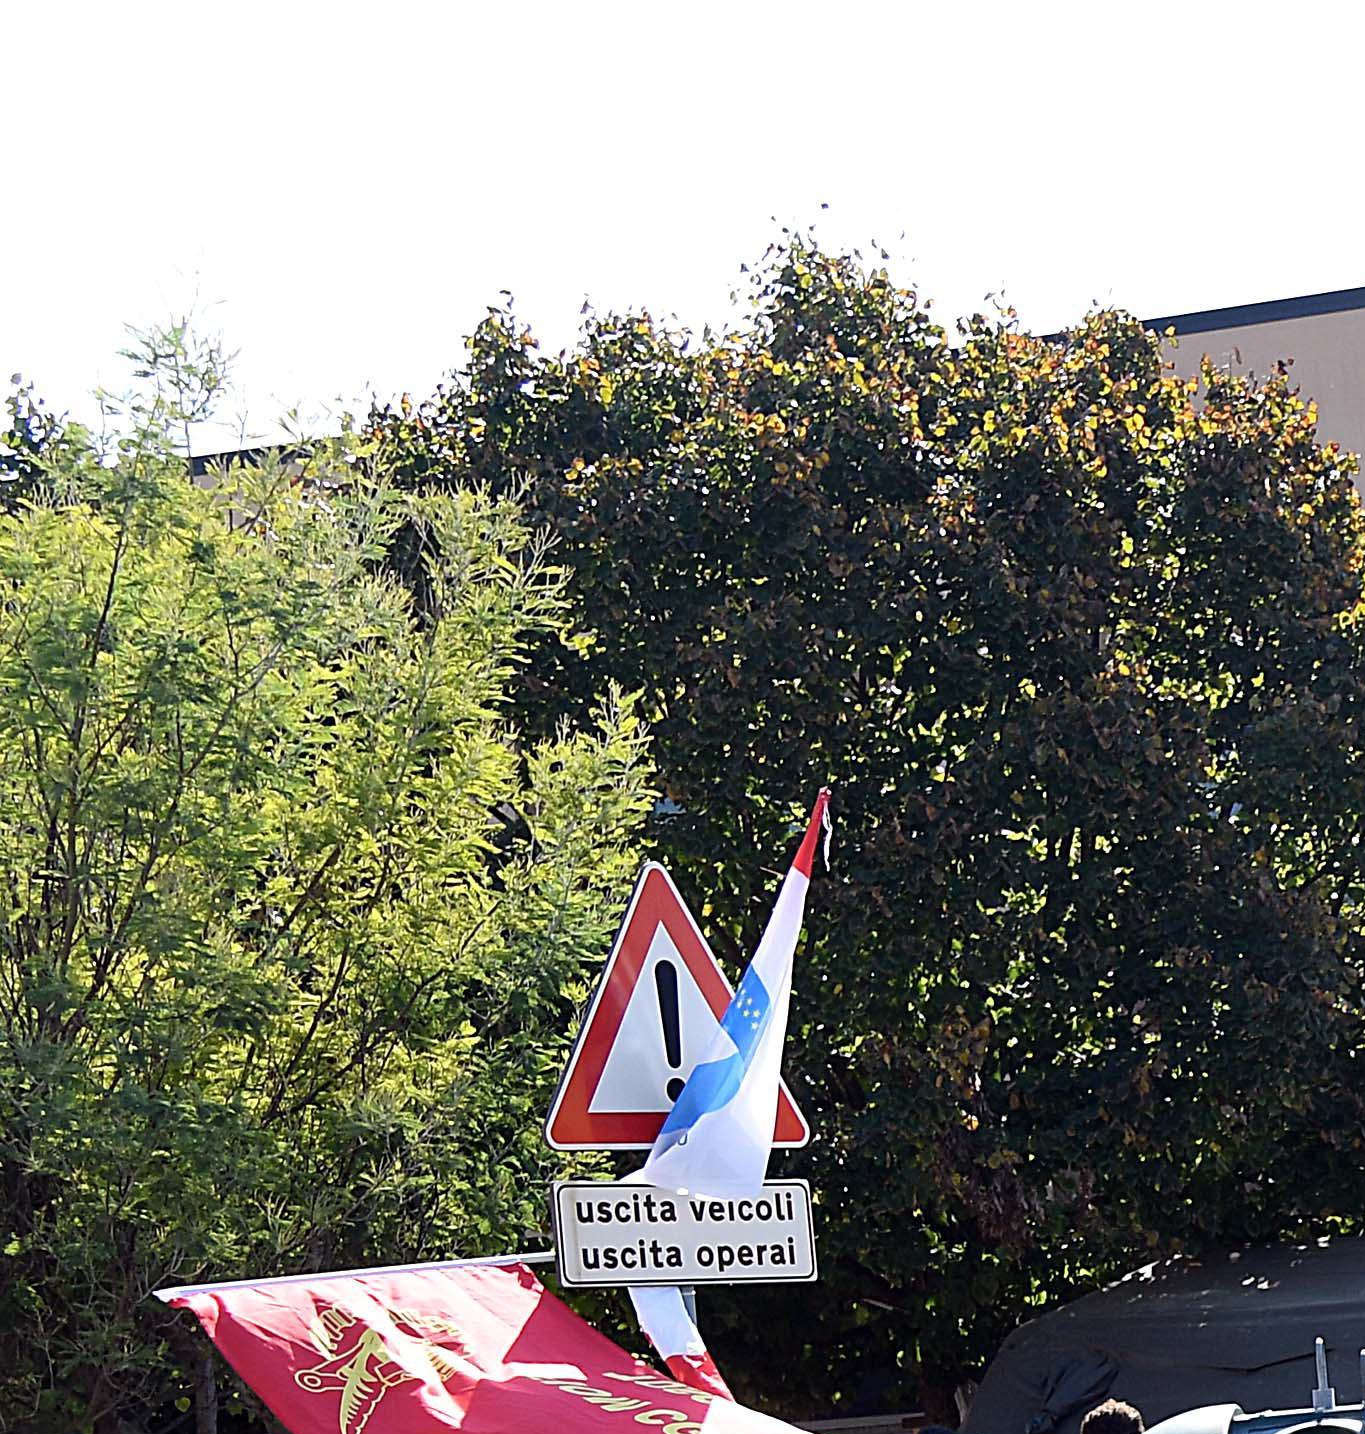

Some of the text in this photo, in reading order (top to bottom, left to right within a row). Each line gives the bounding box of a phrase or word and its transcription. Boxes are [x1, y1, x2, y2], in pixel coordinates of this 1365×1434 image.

[575, 1191, 795, 1223] uscita veicoli
[581, 1237, 796, 1273] uscita operai
